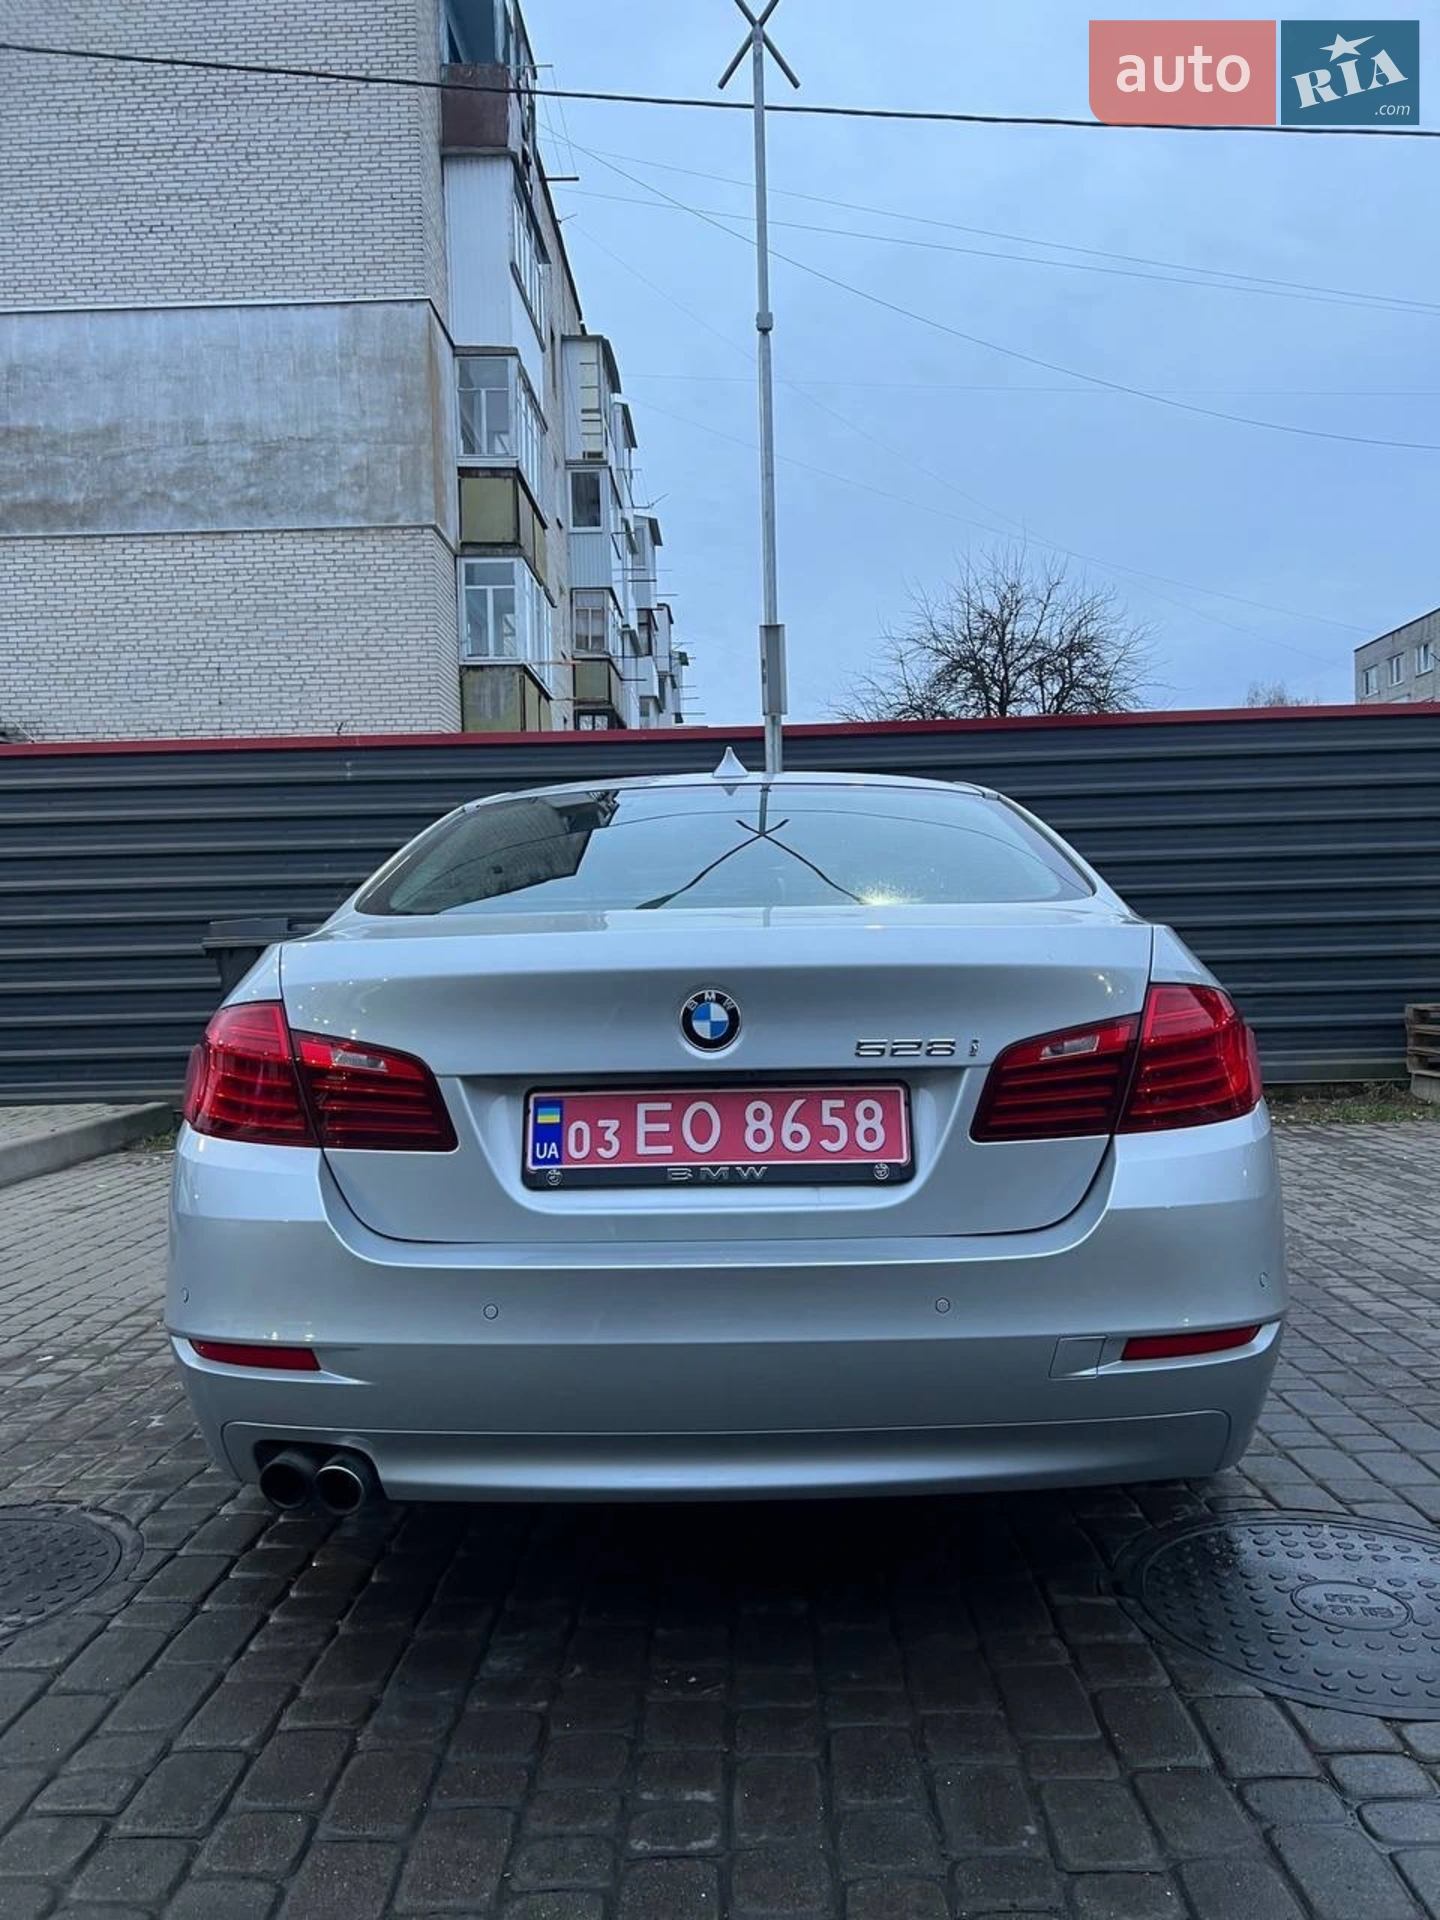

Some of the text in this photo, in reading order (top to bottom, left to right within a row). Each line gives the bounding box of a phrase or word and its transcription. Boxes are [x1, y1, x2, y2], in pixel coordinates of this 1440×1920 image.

[688, 991, 734, 1011] BMW
[567, 1099, 886, 1160] 03 EO 8658
[536, 1143, 559, 1160] UA
[667, 1166, 768, 1181] BMW
